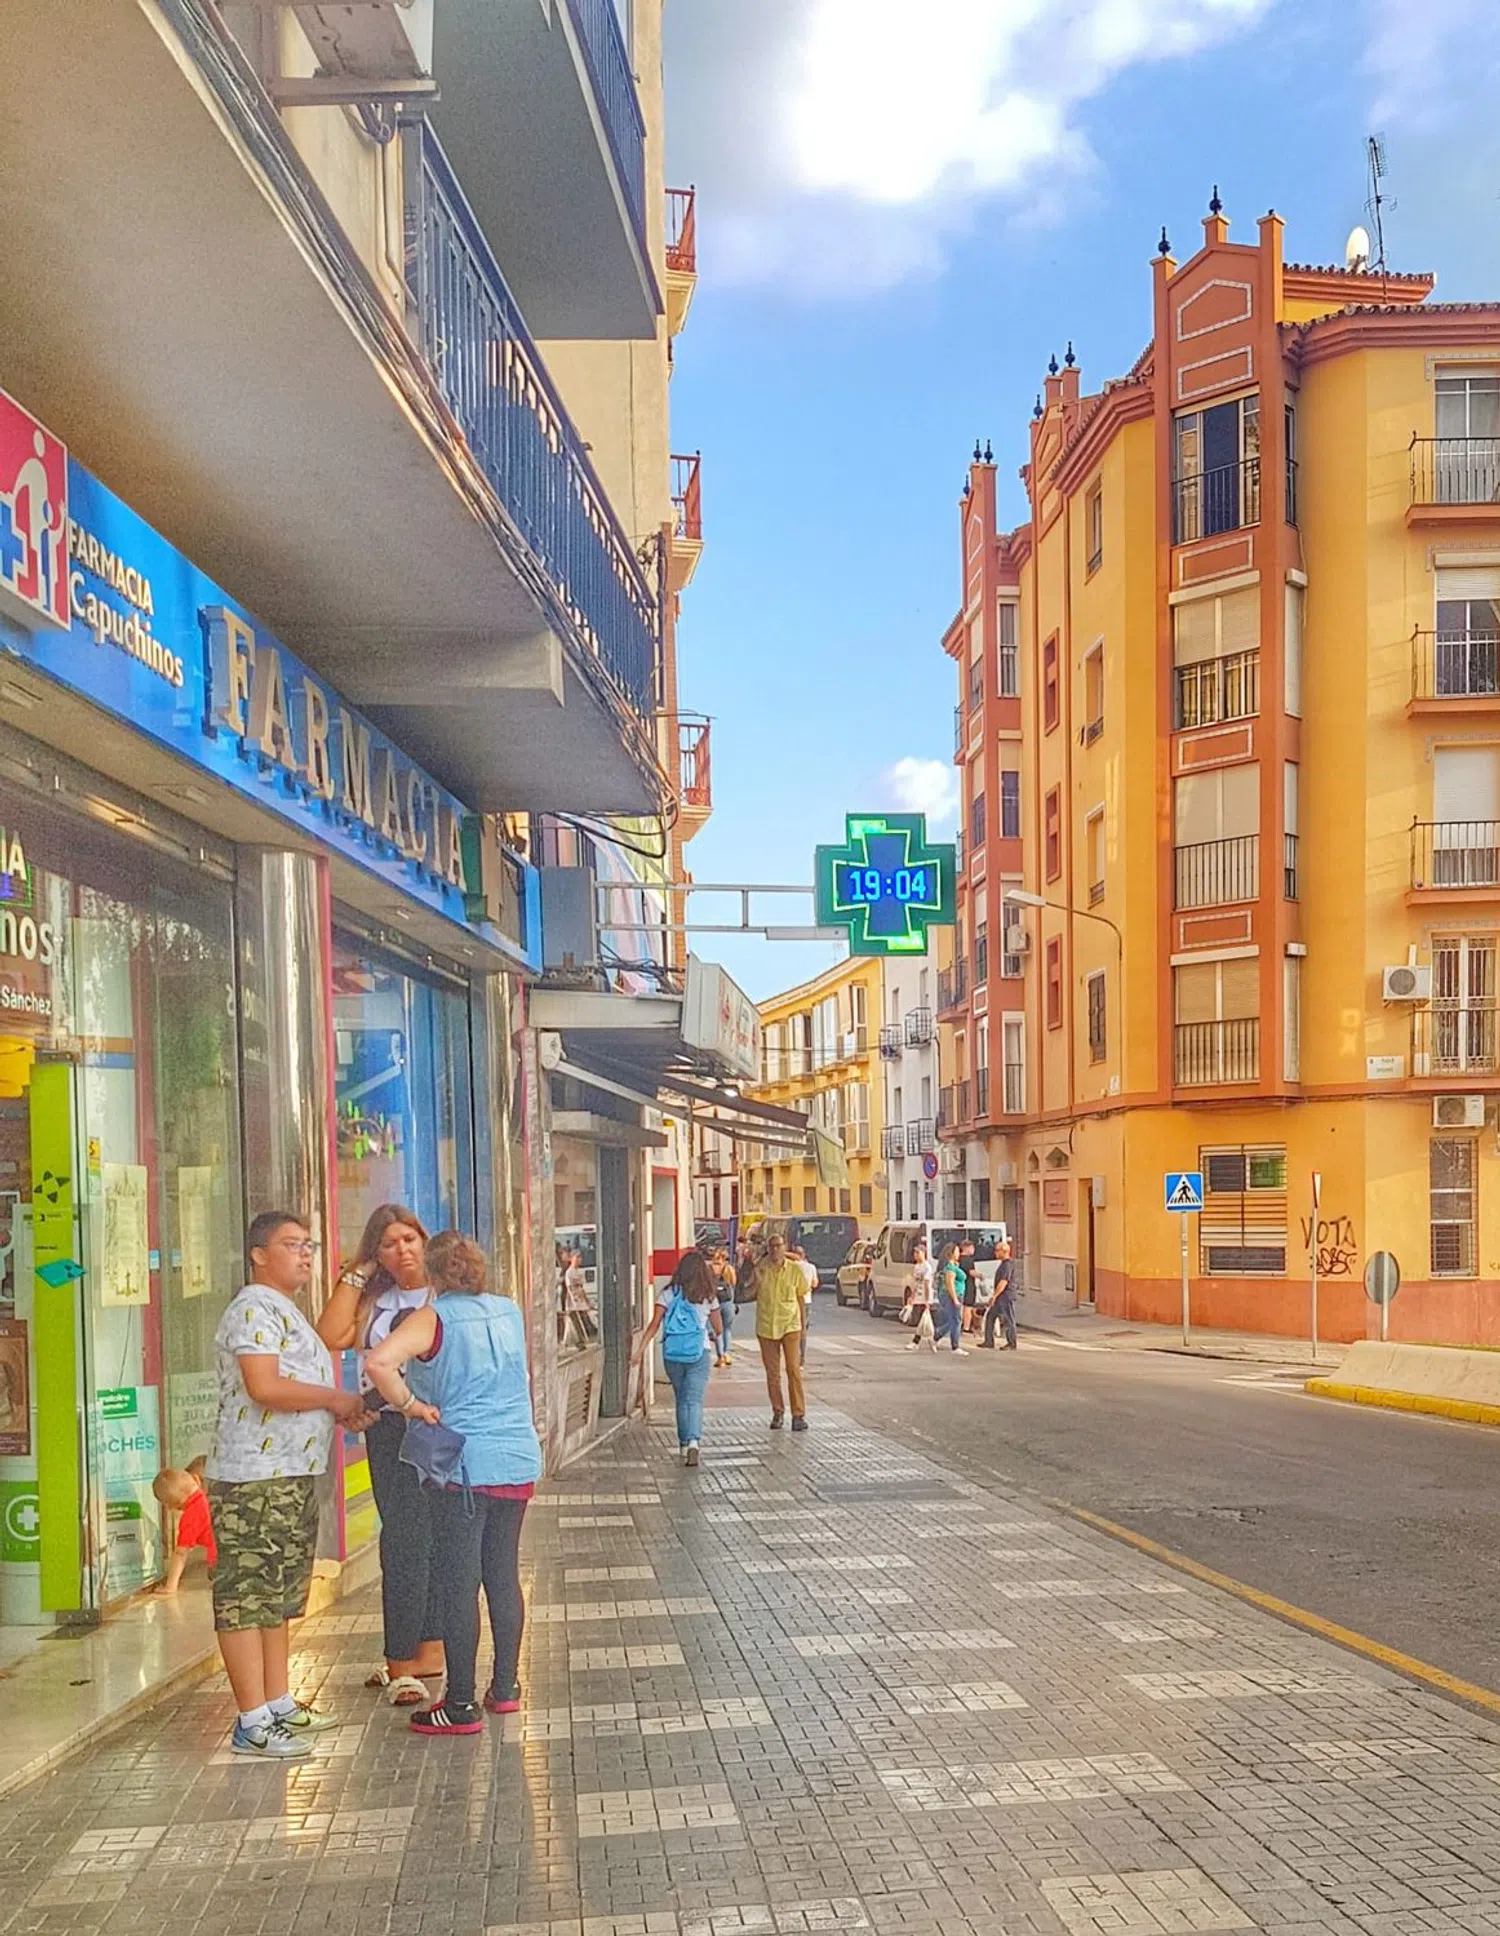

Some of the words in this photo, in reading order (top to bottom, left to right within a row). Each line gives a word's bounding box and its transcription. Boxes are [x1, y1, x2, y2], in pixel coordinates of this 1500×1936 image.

[67, 519, 154, 616] FARMACIA
[70, 571, 184, 687] Capuchinos
[209, 605, 467, 892] FARMACIA
[850, 870, 926, 900] 19:04
[1, 985, 52, 1016] Sánchez
[1300, 1215, 1356, 1249] VOTA
